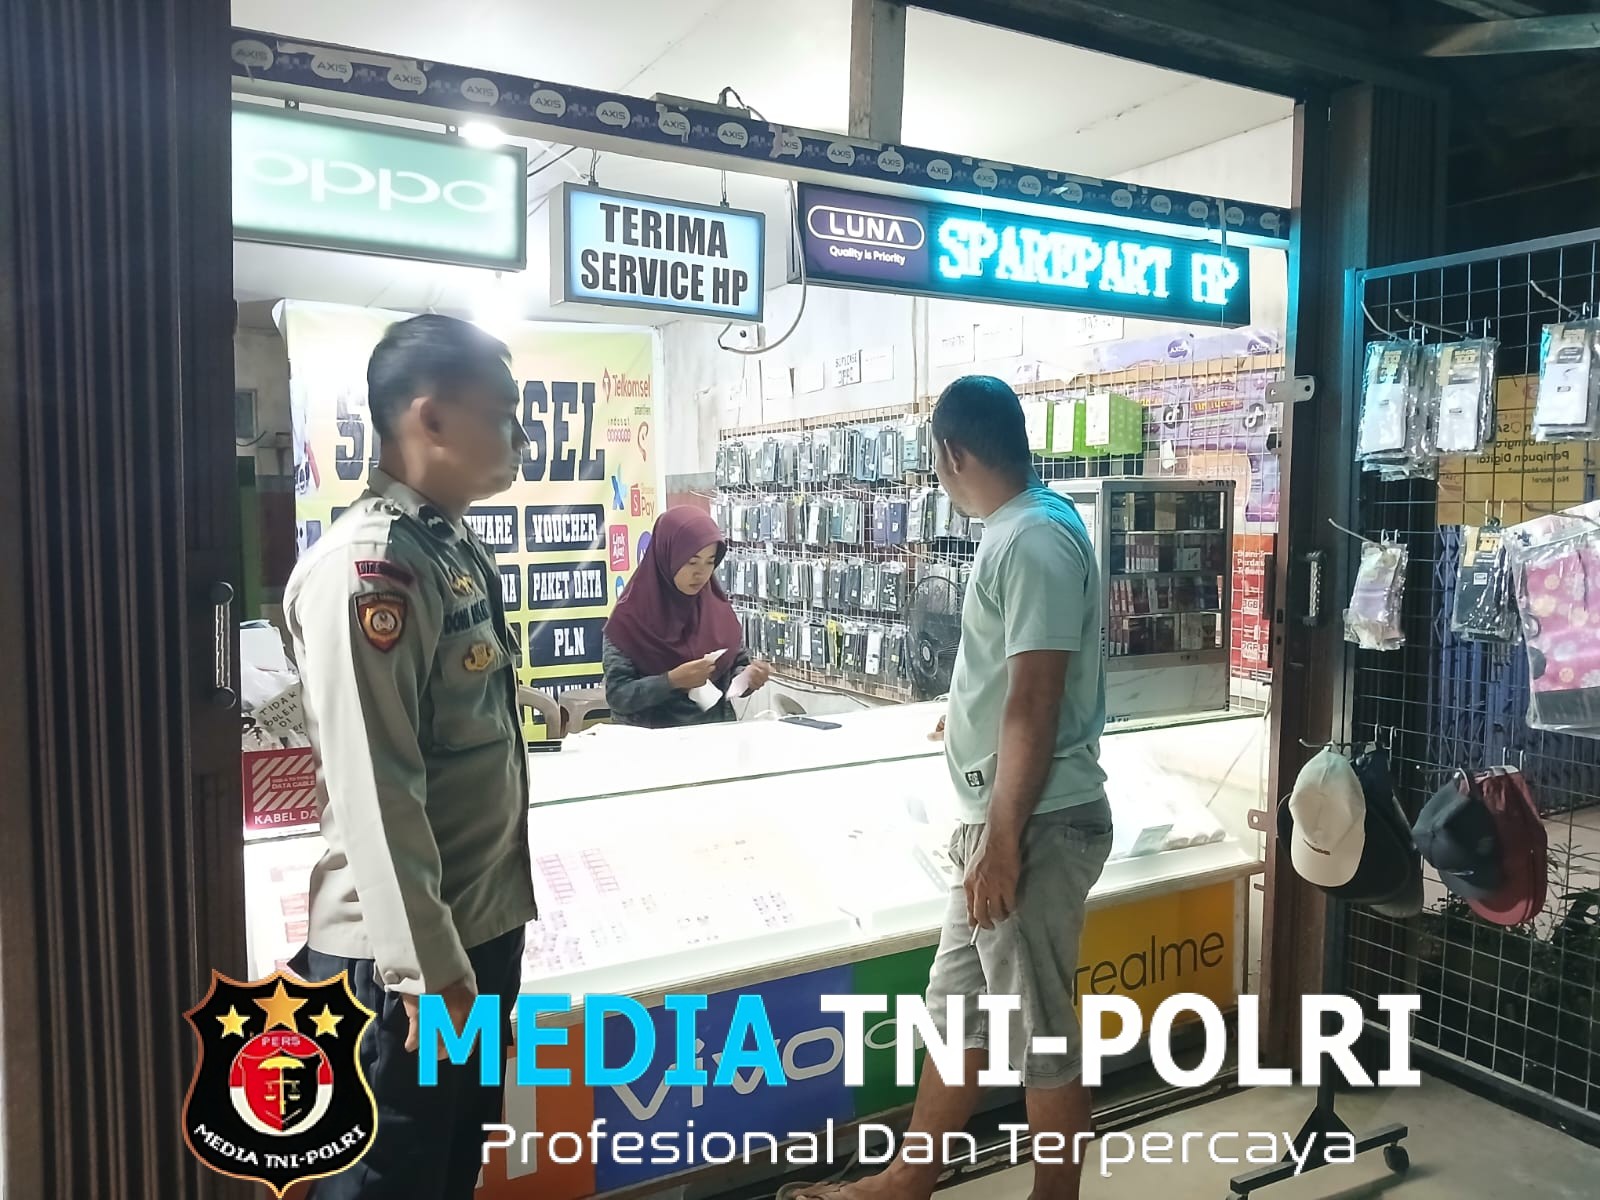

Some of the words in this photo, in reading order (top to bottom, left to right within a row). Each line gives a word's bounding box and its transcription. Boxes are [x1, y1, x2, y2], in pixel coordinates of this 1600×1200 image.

[317, 62, 348, 73] AXIS
[393, 74, 422, 85] AXIS
[466, 86, 494, 96] AXIS
[534, 96, 560, 108] AXIS
[601, 108, 626, 120] AXIS
[663, 119, 686, 130] AXIS
[721, 130, 744, 140] AXIS
[782, 140, 799, 150] XIS
[831, 149, 852, 159] AXIS
[881, 158, 901, 167] AXIS
[930, 166, 950, 175] AXIS
[976, 174, 996, 182] AXIS
[600, 203, 728, 258] TERIMA
[829, 212, 905, 243] LUNA
[829, 245, 864, 261] Quality
[873, 250, 906, 266] Priority
[937, 217, 1172, 298] SPAREPART
[1191, 252, 1240, 305] HP
[581, 249, 704, 302] SERVICE
[712, 267, 748, 306] HP
[612, 373, 651, 398] Telkomsel
[641, 496, 655, 521] Pay
[532, 513, 598, 543] VOUCHER
[533, 571, 570, 601] PAKET
[573, 569, 603, 599] DATA
[554, 627, 585, 657] PLN
[259, 691, 297, 716] TIDAK
[263, 703, 298, 726] BOLEH
[254, 812, 296, 825] KABEL
[300, 810, 319, 820] DA
[1073, 932, 1224, 1006] realme
